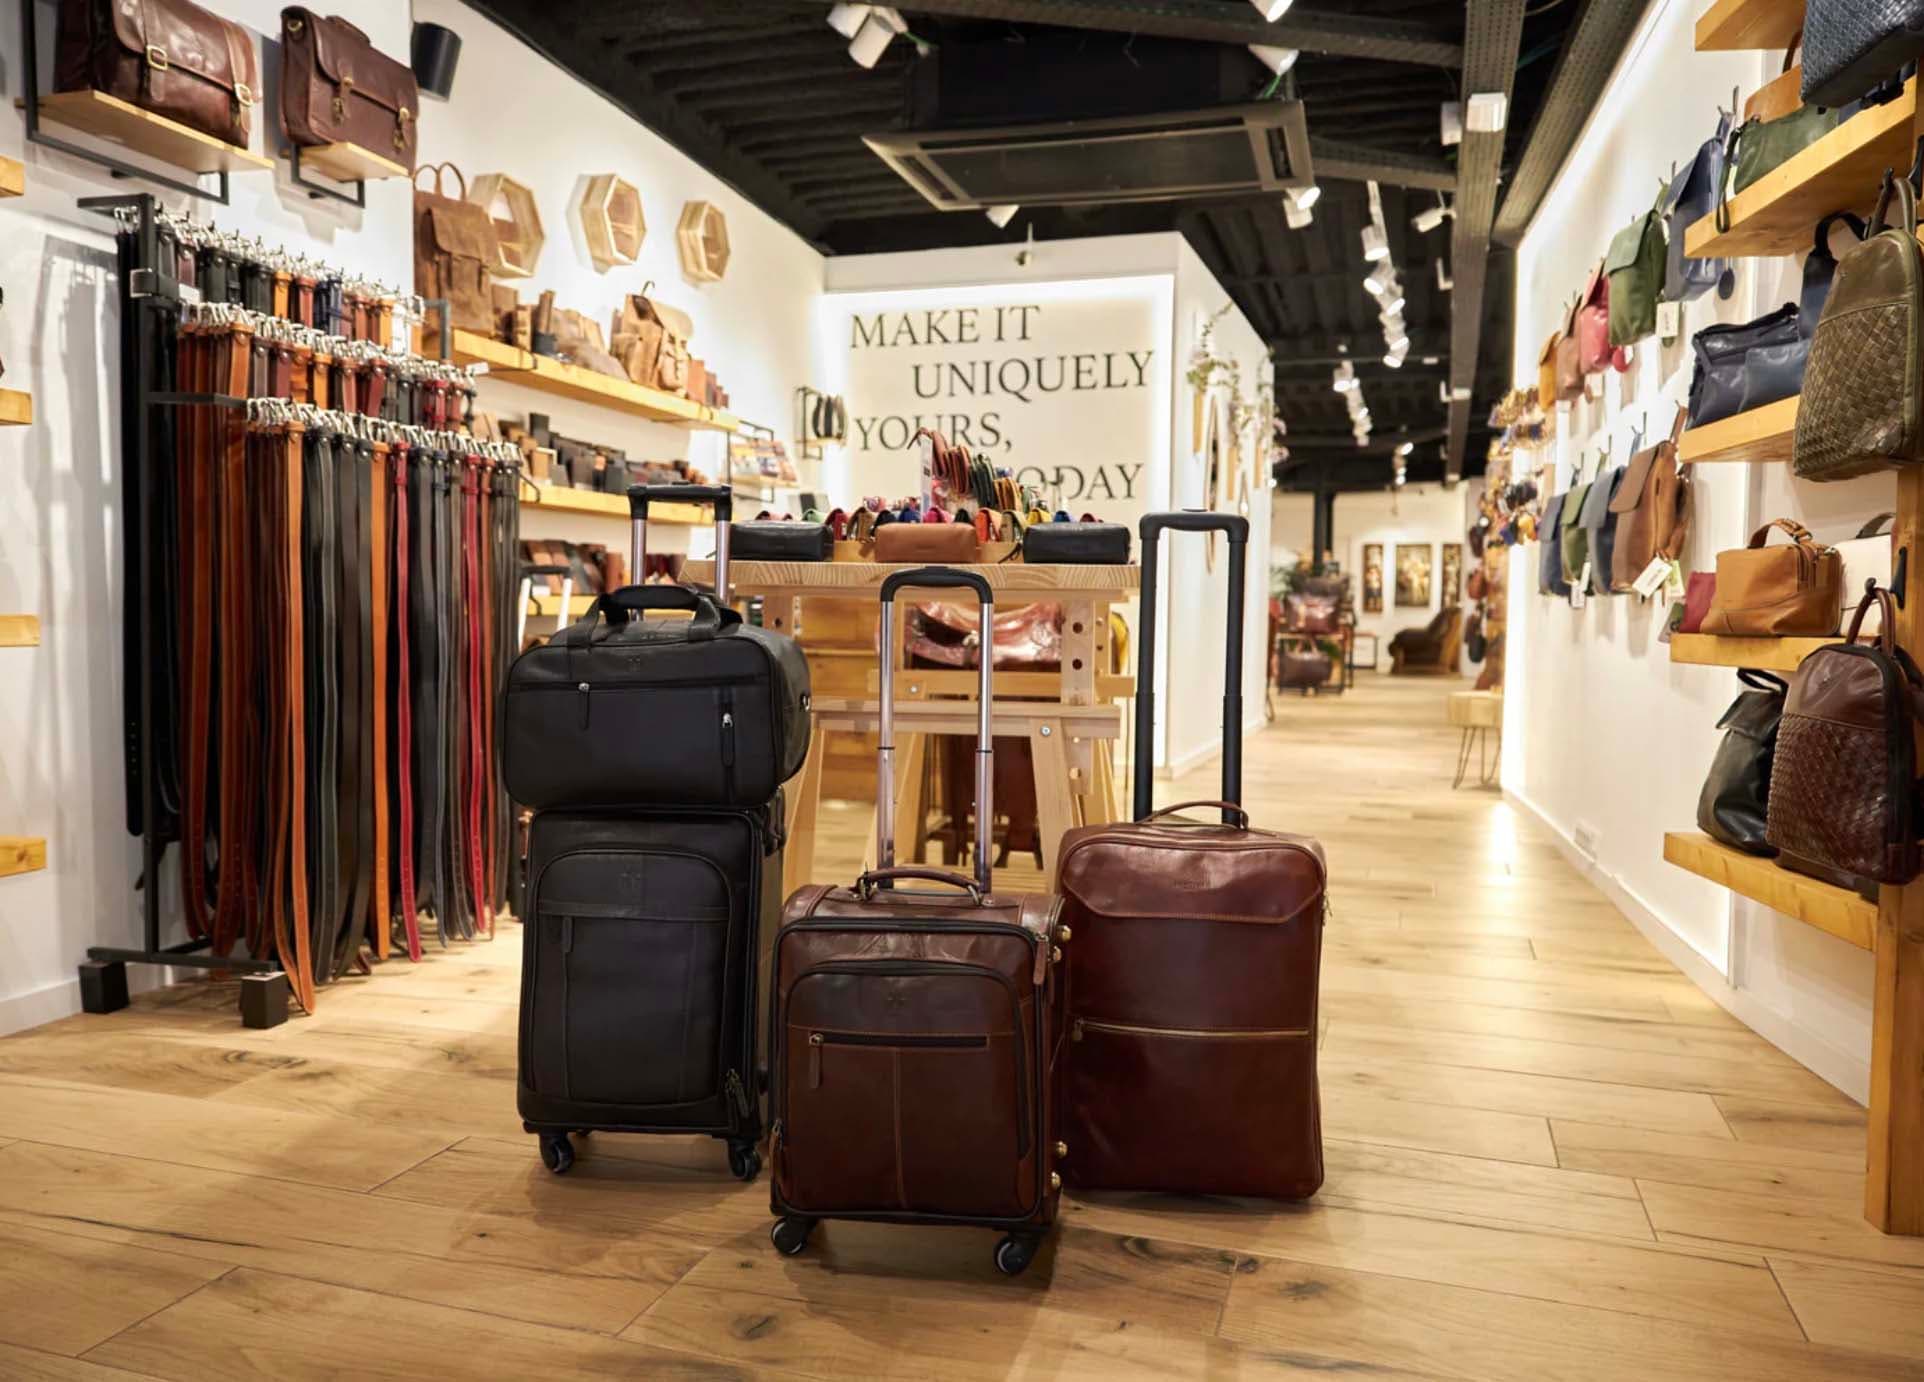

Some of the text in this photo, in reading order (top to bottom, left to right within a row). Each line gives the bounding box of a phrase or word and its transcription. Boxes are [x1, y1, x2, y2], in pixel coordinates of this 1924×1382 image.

[851, 305, 1041, 348] MAKE IT
[912, 350, 1154, 402] UNIQUELY
[1015, 463, 1144, 502] ODAY
